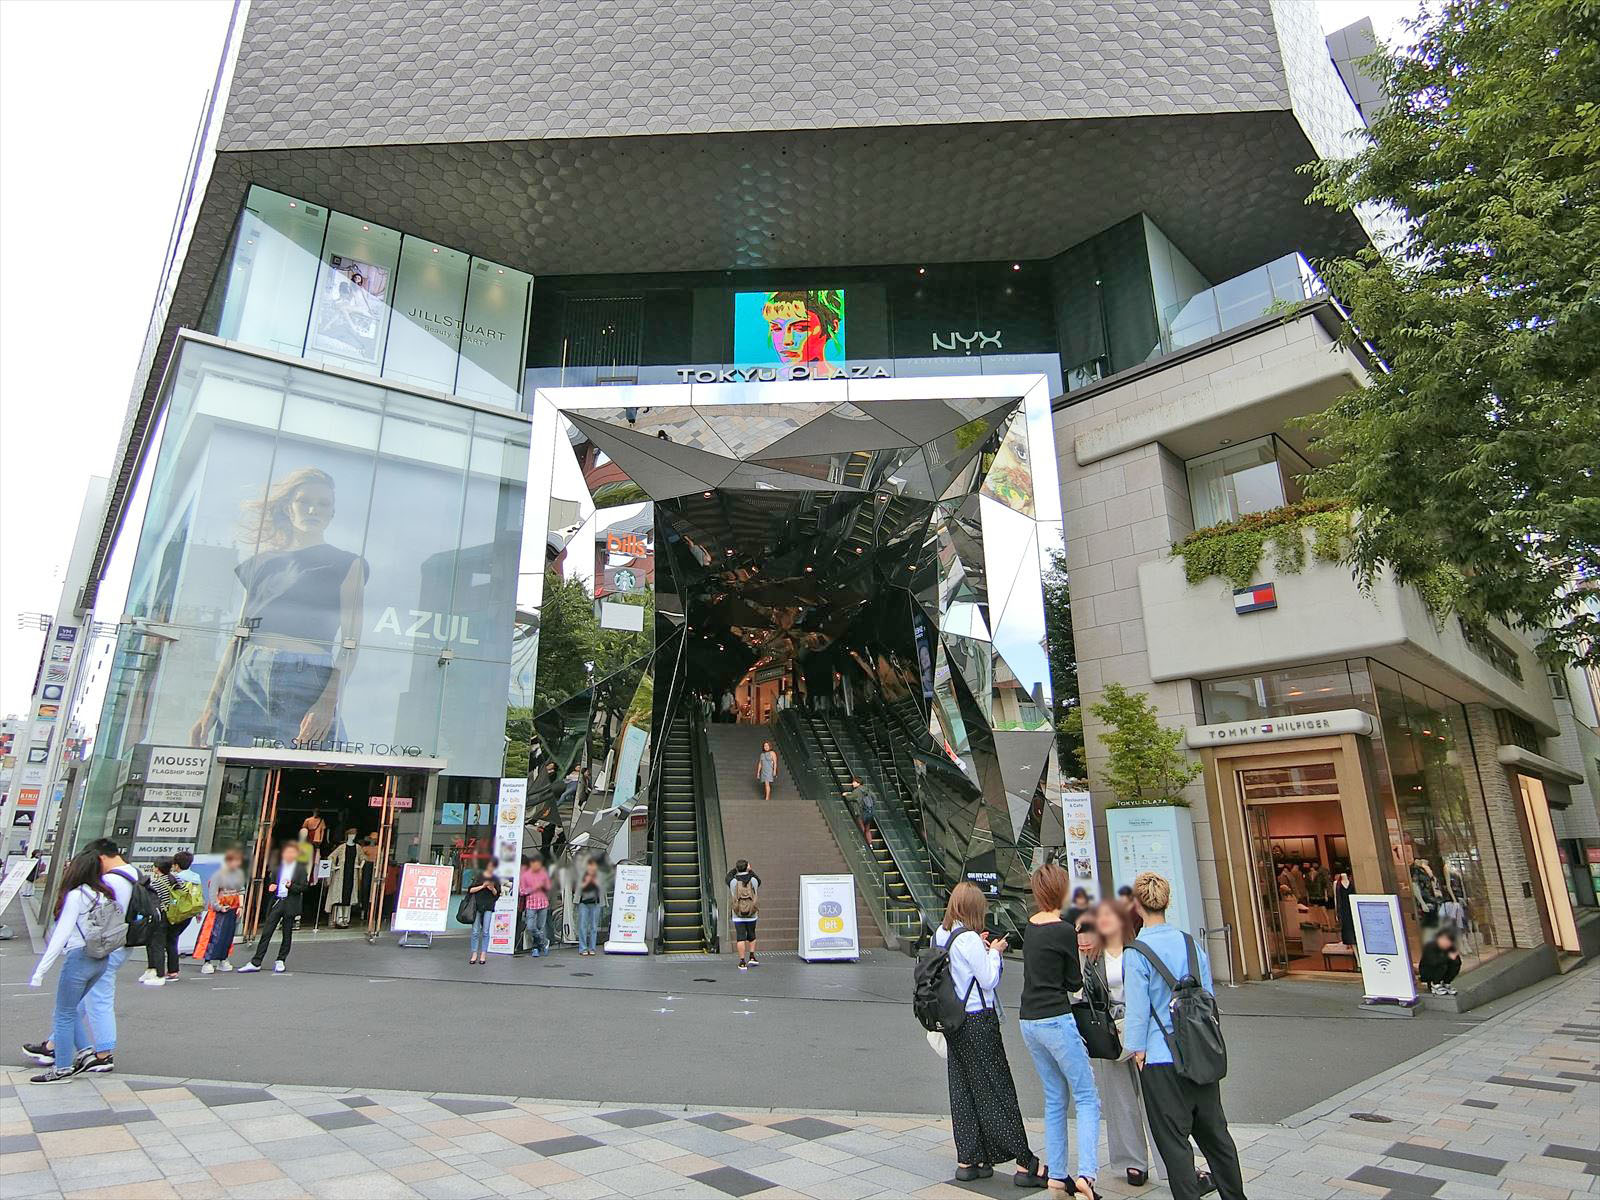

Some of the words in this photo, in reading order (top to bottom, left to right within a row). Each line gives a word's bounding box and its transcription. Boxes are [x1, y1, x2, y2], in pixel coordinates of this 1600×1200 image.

[424, 324, 452, 338] Beauty
[932, 330, 1002, 351] NYX
[677, 368, 776, 384] TOKYU
[788, 365, 891, 381] PLAZA
[607, 532, 646, 556] bills
[372, 606, 480, 645] AZUL
[1209, 726, 1257, 739] TOMMY
[1276, 719, 1331, 732] HILFIGER
[254, 735, 285, 750] The
[370, 743, 422, 757] TOKYO
[153, 756, 207, 767] MOUSSY
[149, 812, 191, 823] AZUL
[413, 886, 438, 898] TAX
[407, 896, 441, 909] FREE
